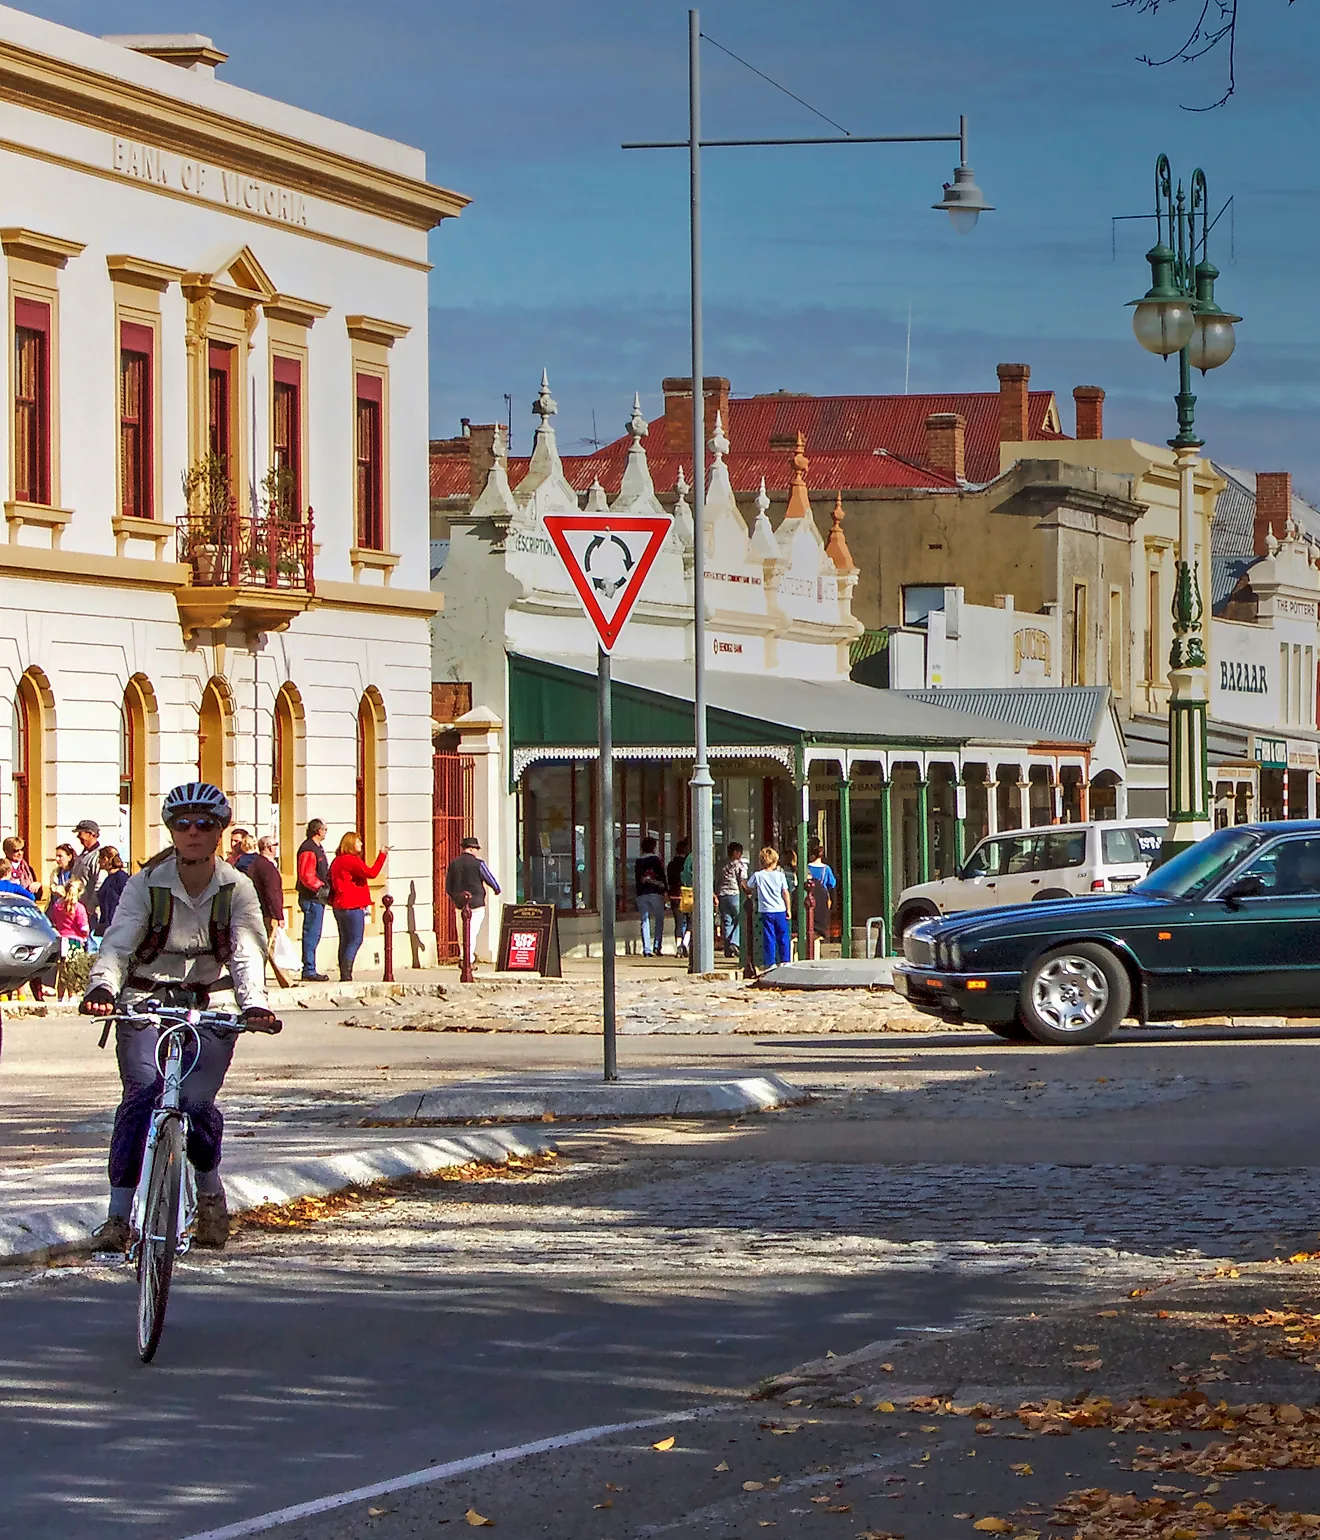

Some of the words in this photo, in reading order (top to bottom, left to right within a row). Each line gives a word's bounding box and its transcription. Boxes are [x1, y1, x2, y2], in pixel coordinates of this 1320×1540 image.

[112, 137, 167, 184] BANK
[180, 158, 206, 194] OF
[221, 170, 307, 226] VICTORIA
[1276, 599, 1289, 613] THE
[1290, 601, 1316, 617] POTTERS
[1220, 660, 1268, 694] BAZAAR
